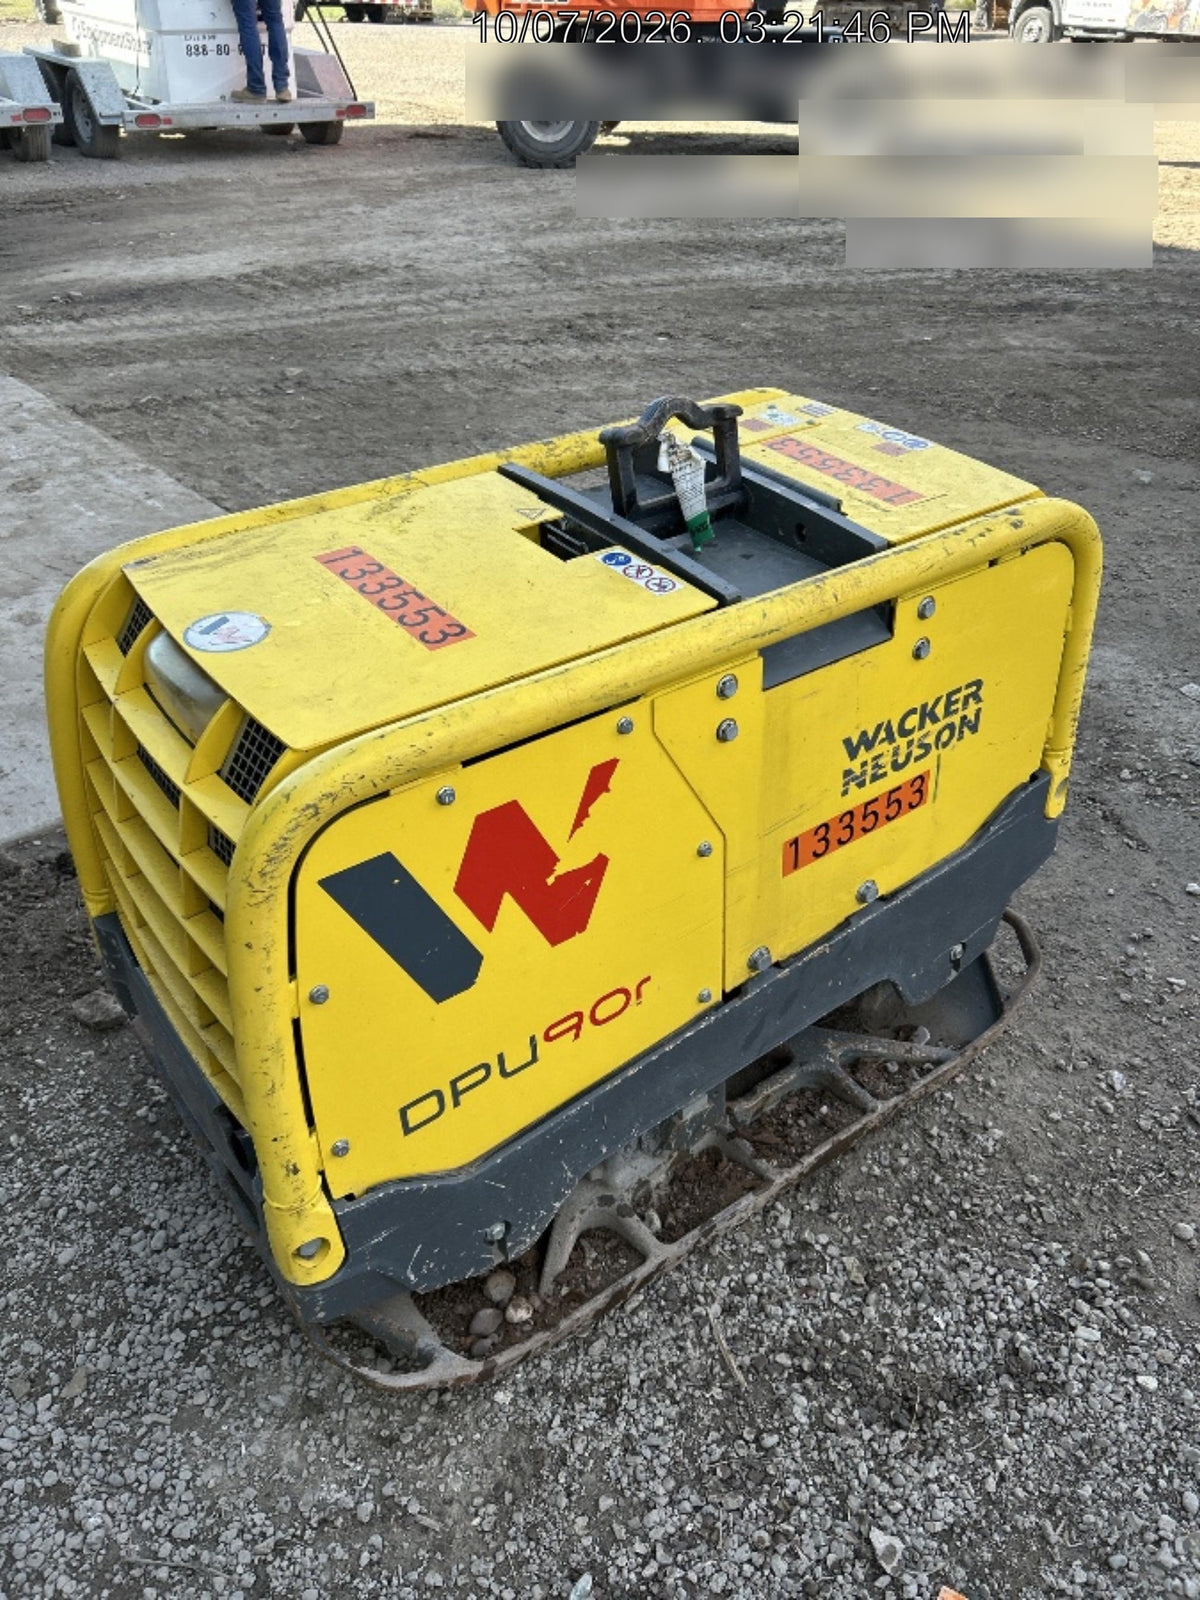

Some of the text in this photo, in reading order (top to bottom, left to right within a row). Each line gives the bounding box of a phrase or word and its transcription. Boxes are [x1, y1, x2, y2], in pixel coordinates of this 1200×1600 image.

[767, 438, 911, 502] 133553
[323, 549, 467, 645] 133553
[841, 707, 982, 797] NEUSON
[842, 679, 984, 761] WACKER
[788, 774, 926, 870] 133553
